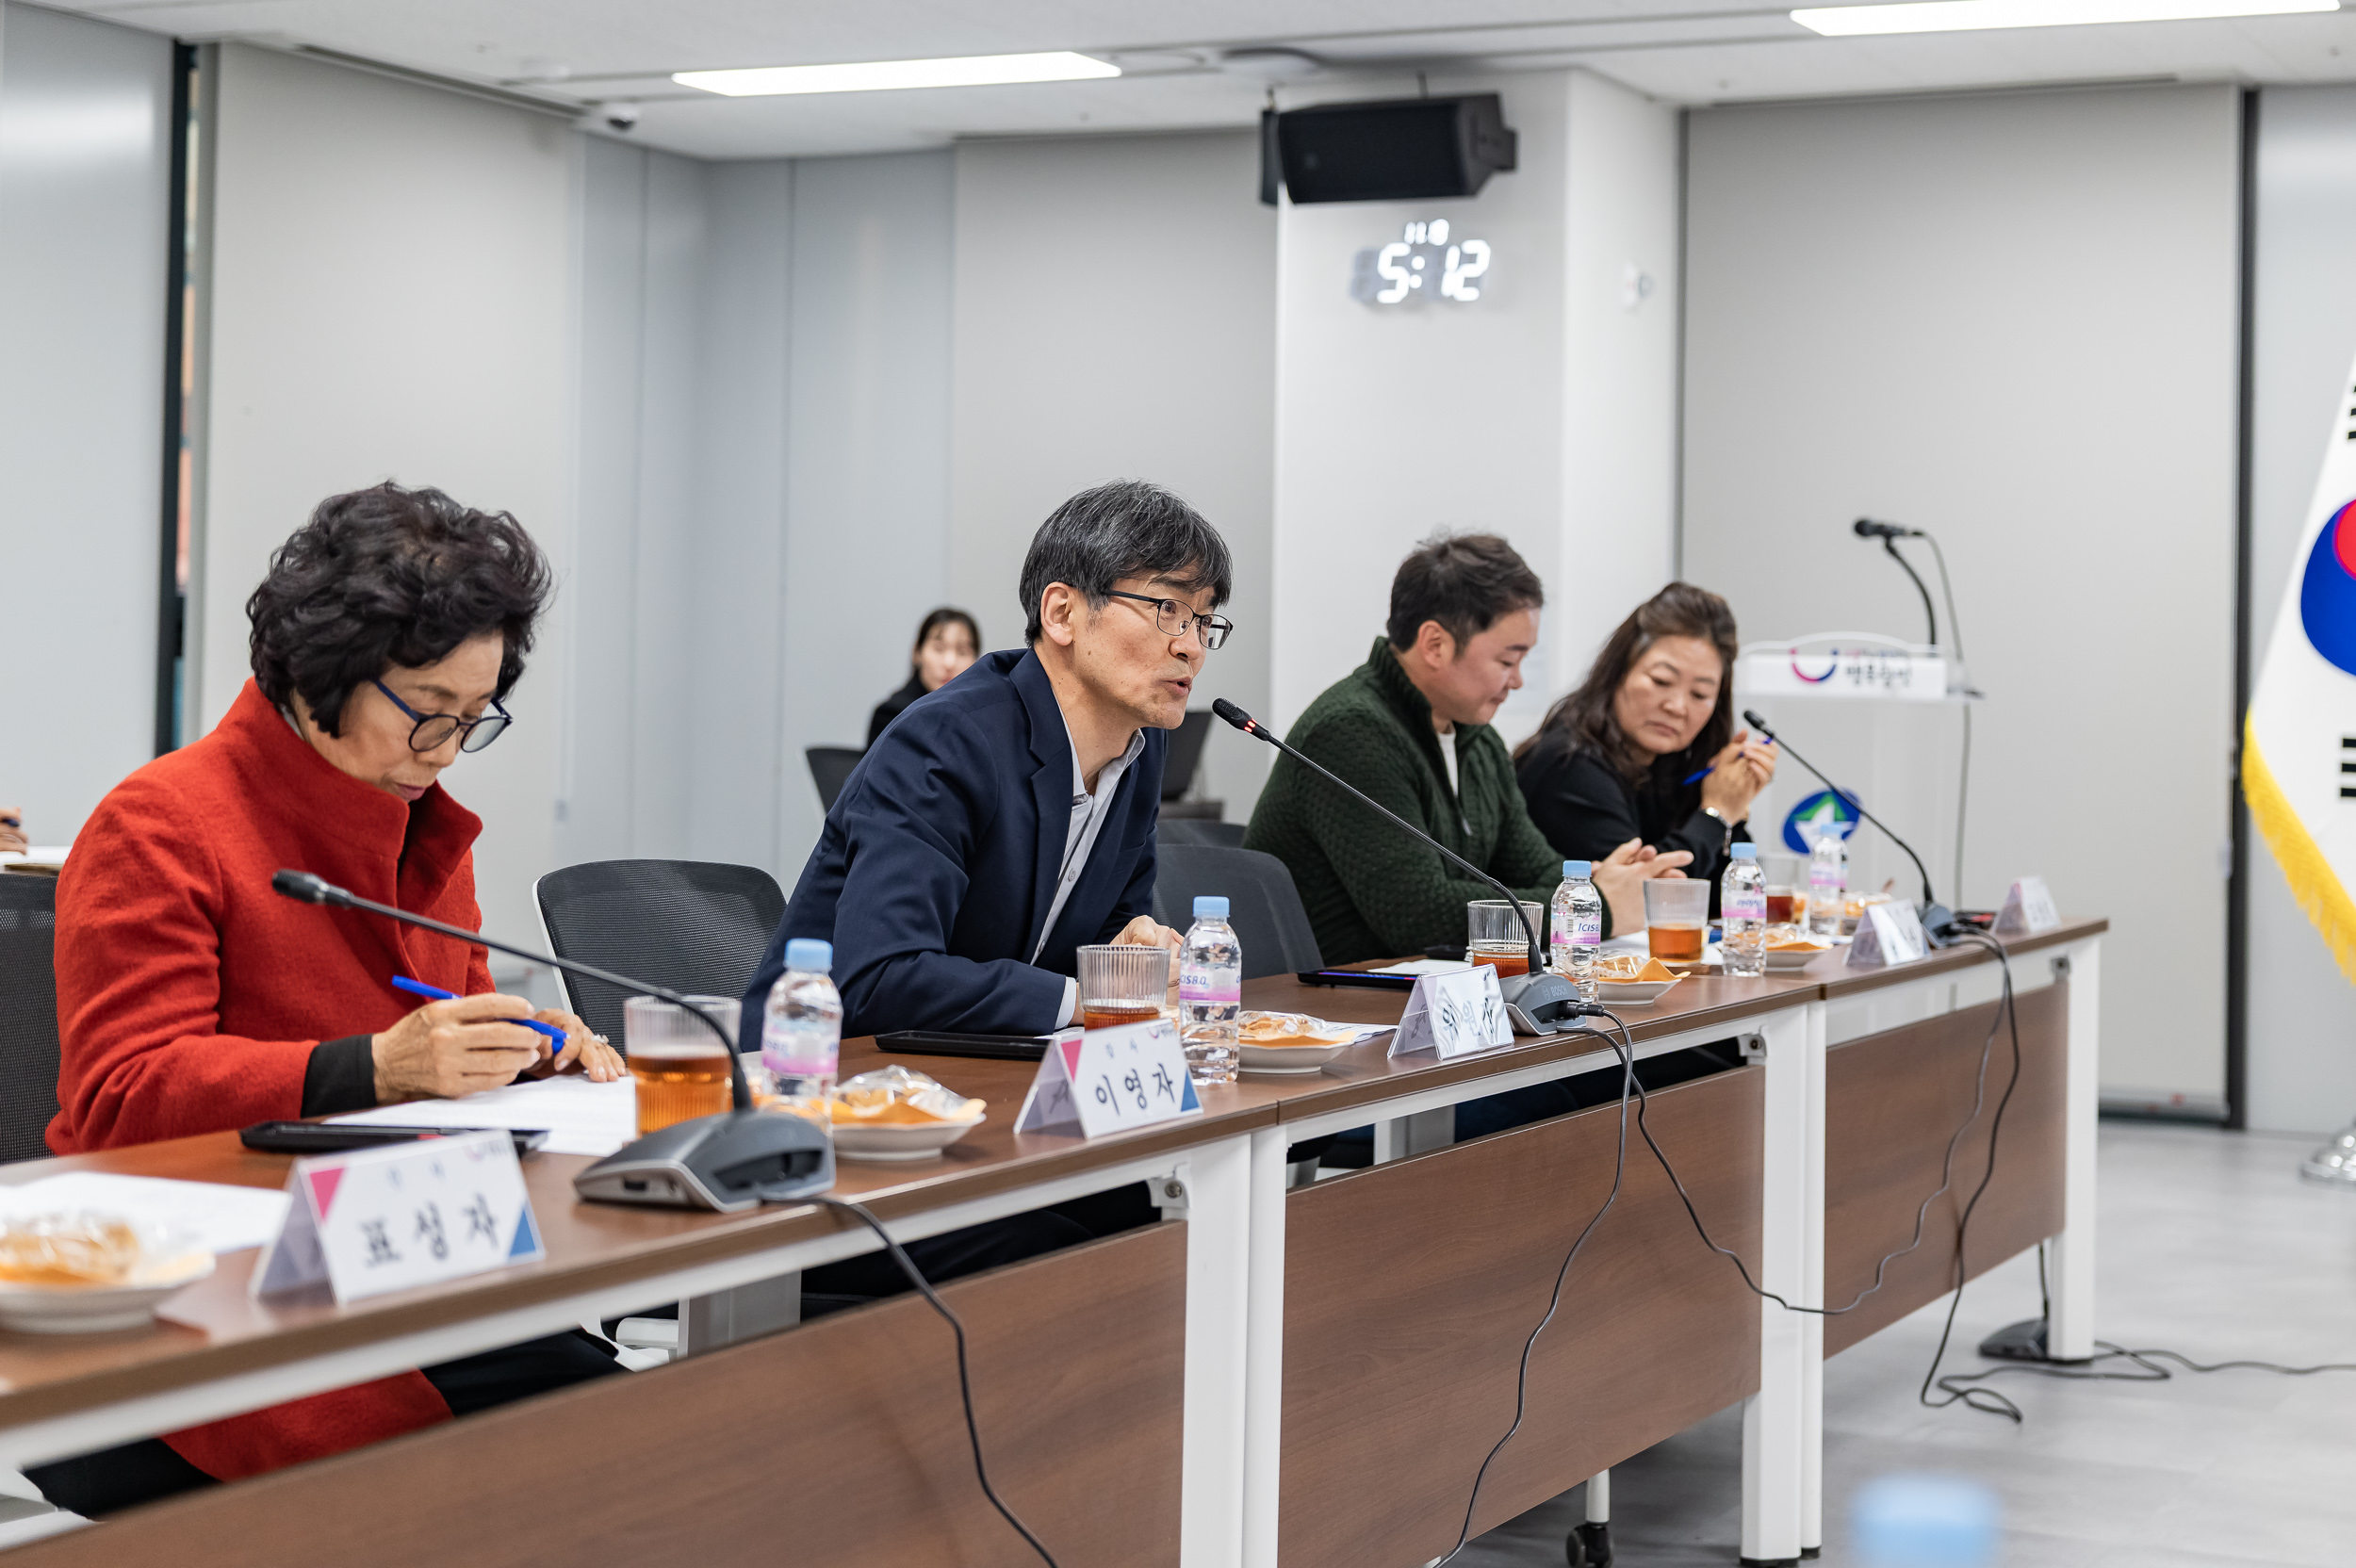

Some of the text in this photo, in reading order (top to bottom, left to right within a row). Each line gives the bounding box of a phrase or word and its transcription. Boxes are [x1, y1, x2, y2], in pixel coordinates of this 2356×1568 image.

[1377, 239, 1491, 303] 5:12
[1549, 985, 1569, 997] BOSCH
[1095, 1063, 1176, 1117] 이영자
[359, 1192, 499, 1268] 표성자
